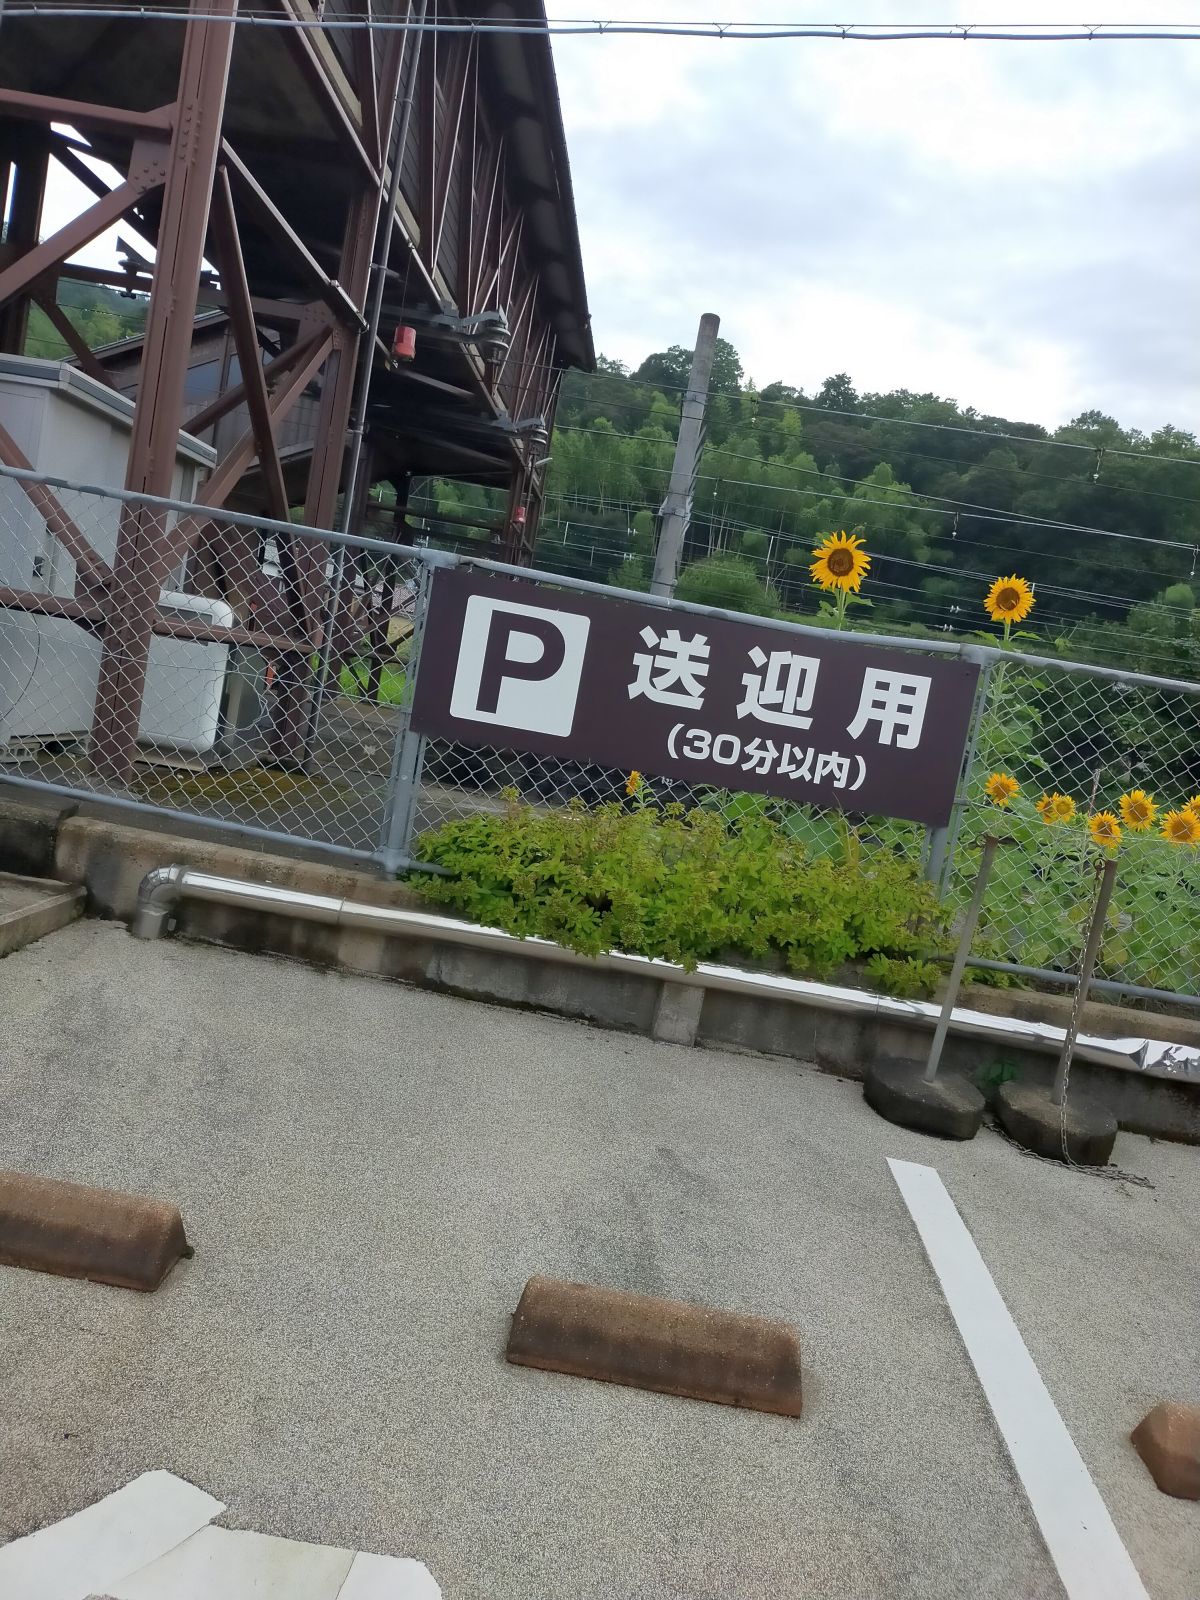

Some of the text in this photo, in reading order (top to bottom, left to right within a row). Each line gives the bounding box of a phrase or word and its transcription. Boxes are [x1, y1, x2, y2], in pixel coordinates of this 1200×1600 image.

[476, 609, 566, 715] P
[628, 625, 933, 750] 送迎用
[667, 723, 867, 791] (30分以内)
